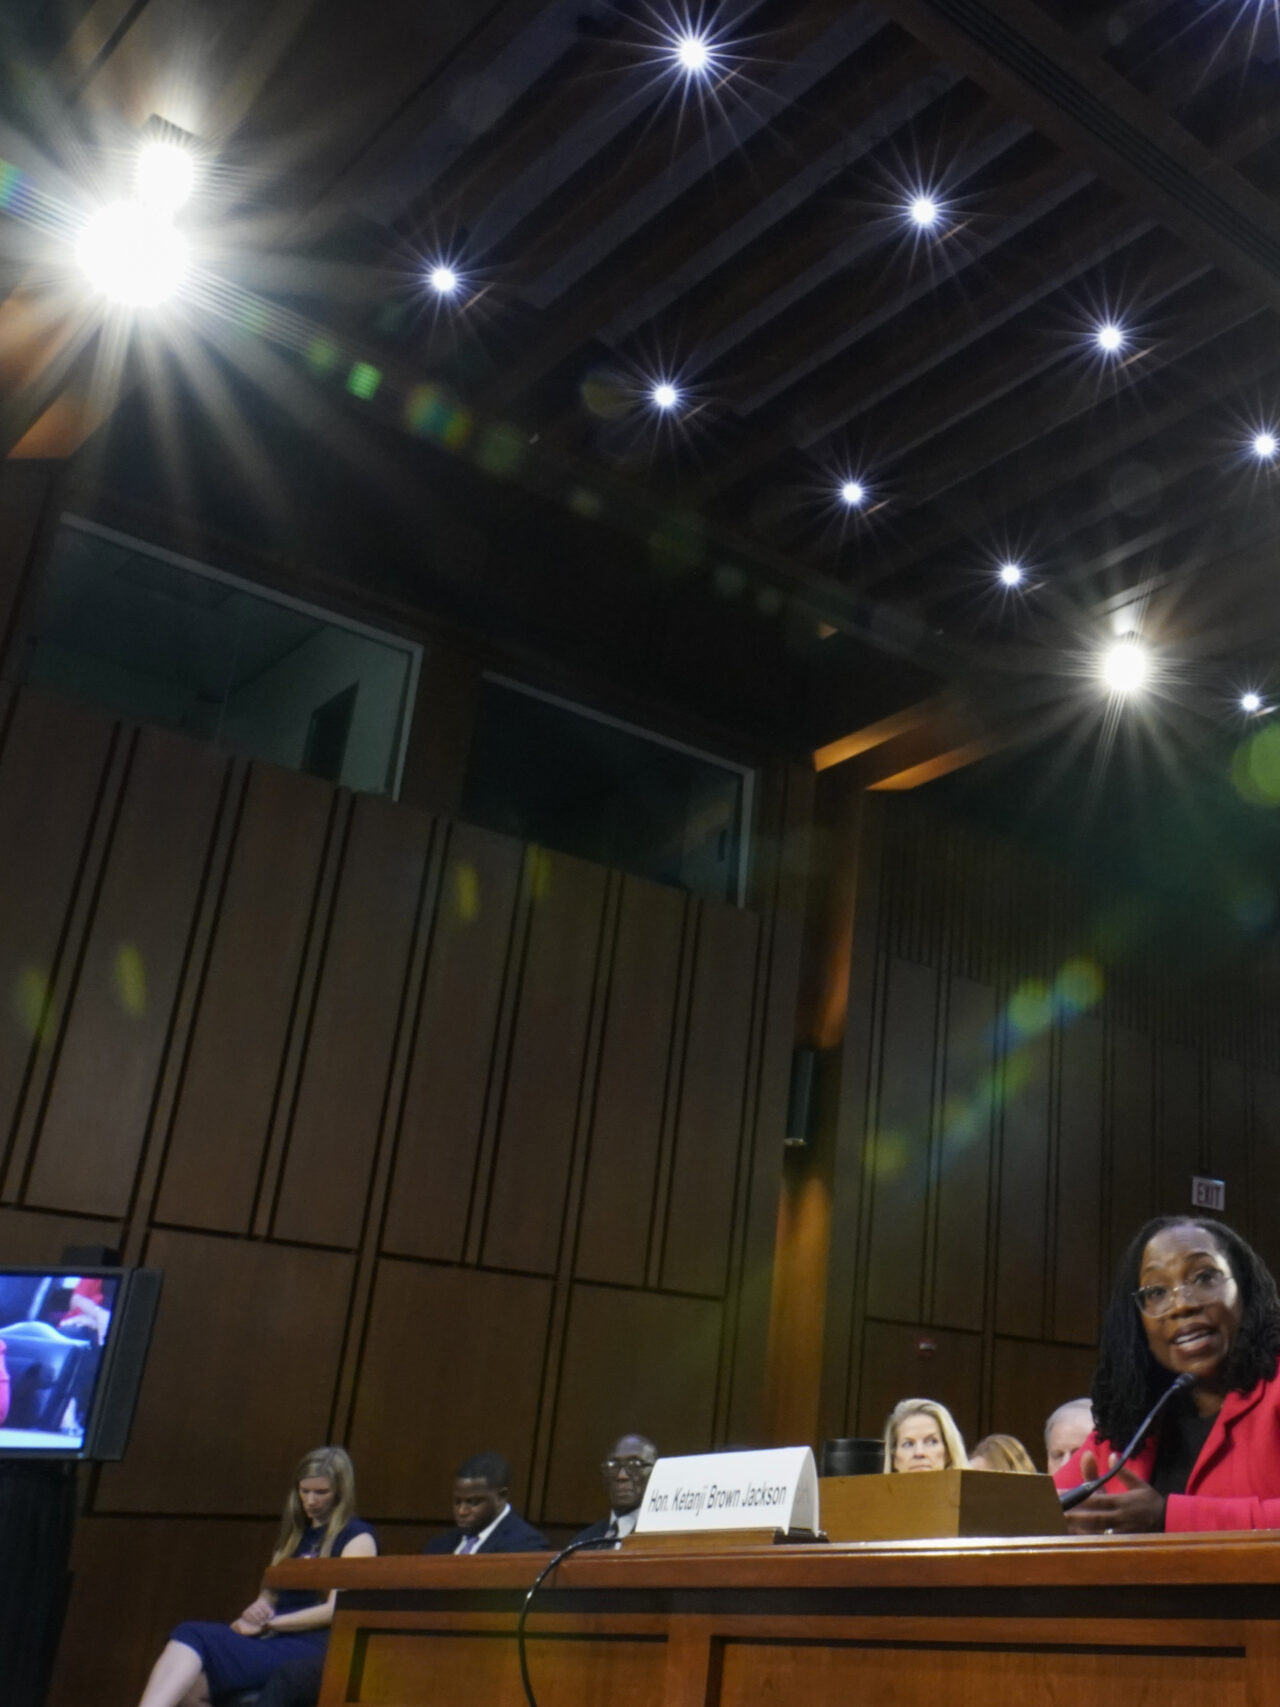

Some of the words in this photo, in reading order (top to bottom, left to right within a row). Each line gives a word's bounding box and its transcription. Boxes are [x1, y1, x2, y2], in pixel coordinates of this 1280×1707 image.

[1197, 1182, 1222, 1207] EXIT
[648, 1488, 669, 1512] Hon.
[671, 1485, 707, 1517] Ketanji
[707, 1484, 741, 1509] Brown
[742, 1481, 787, 1507] Jackson
